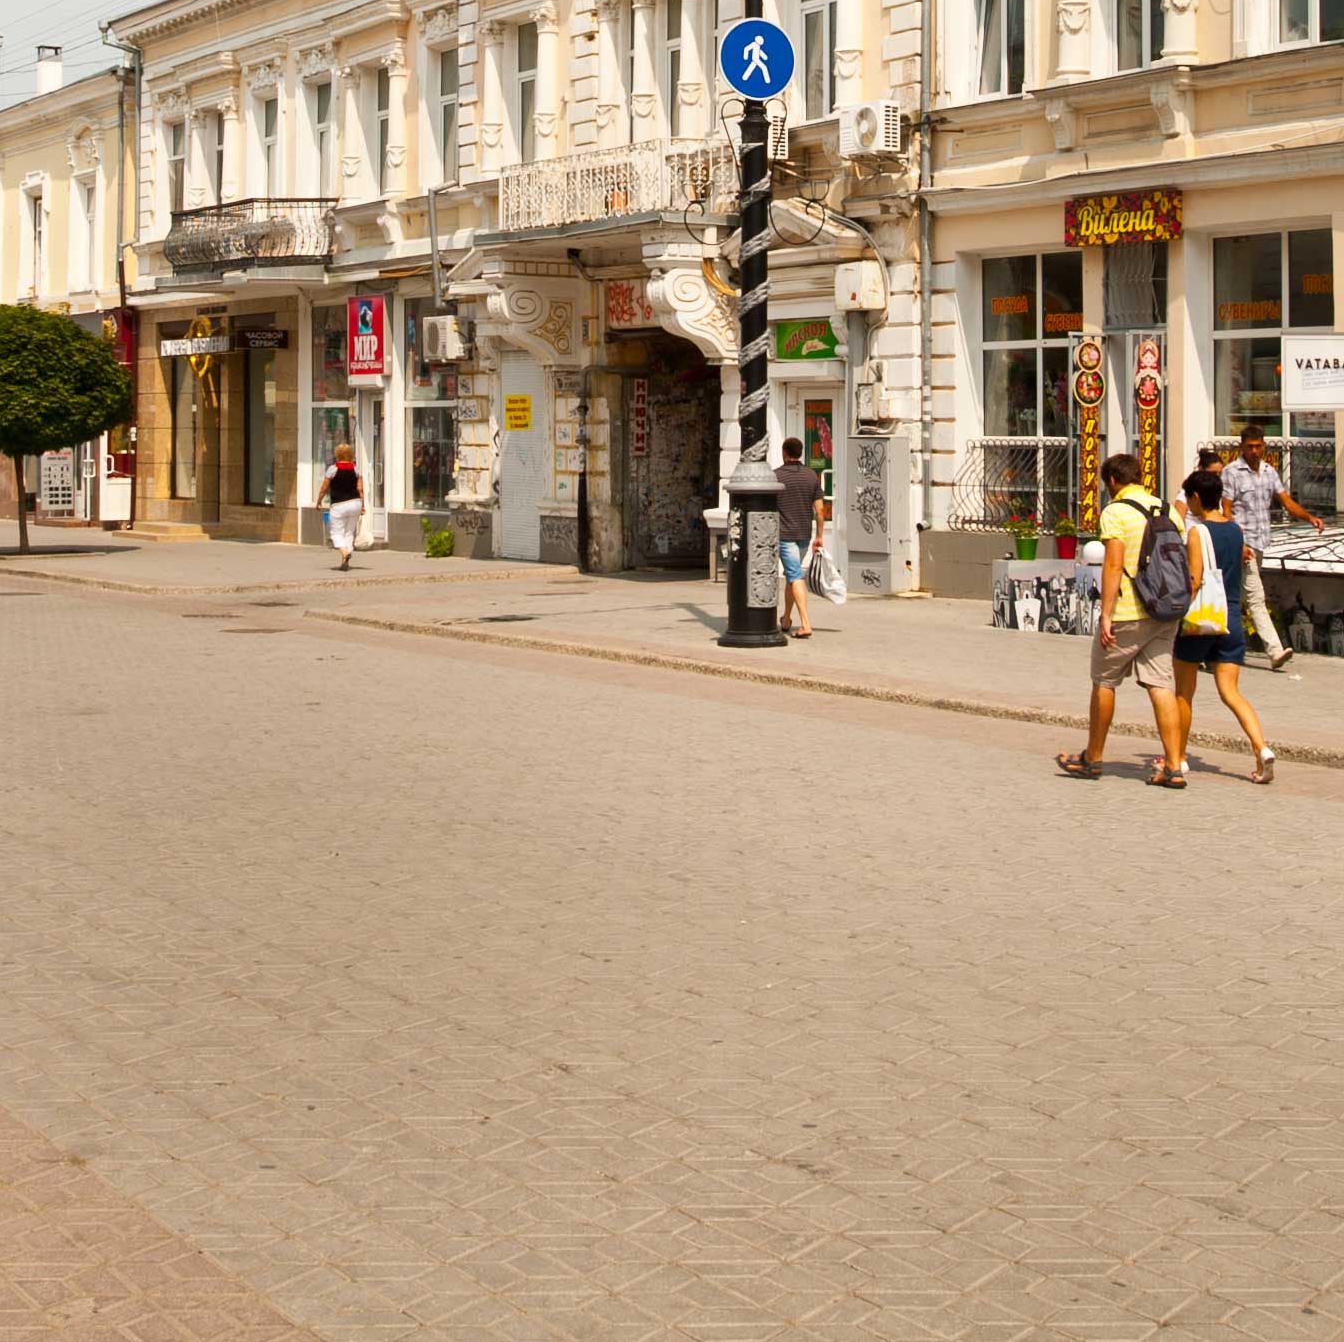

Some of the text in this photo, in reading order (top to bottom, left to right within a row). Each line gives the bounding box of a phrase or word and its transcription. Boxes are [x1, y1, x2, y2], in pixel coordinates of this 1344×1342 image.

[1079, 206, 1155, 236] Вилена
[354, 335, 378, 361] МИР
[1083, 419, 1096, 521] ПОСУДА
